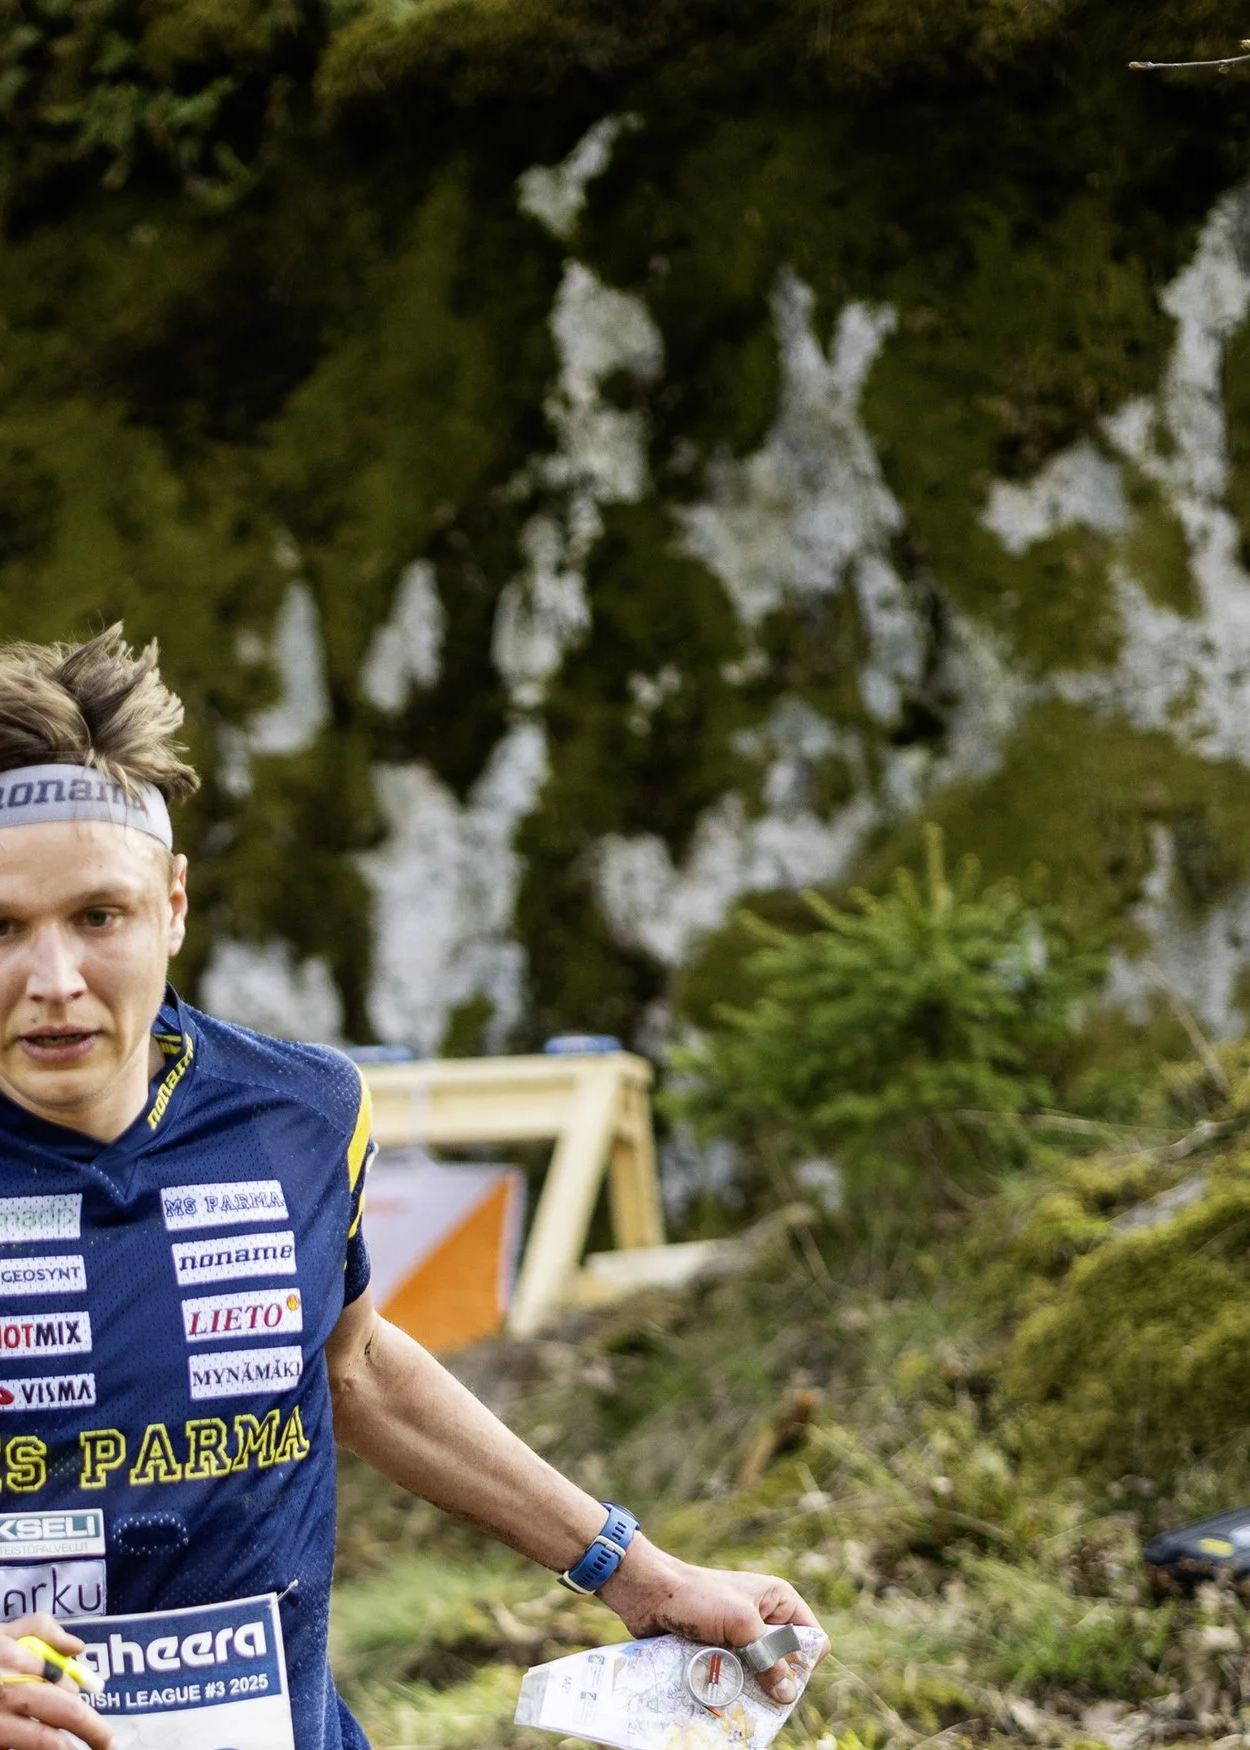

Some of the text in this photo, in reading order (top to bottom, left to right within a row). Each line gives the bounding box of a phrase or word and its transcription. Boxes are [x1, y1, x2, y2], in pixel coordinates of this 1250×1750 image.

[164, 1192, 284, 1217] MS PARMA
[179, 1245, 293, 1271] noname
[1, 1266, 80, 1283] GEOSYNT
[189, 1303, 283, 1335] LIETO
[192, 1360, 302, 1387] MYNÄMÄKI
[21, 1380, 92, 1404] VISMA
[79, 1405, 311, 1490] PARMA
[77, 1621, 267, 1681] gheera
[78, 1674, 269, 1709] DISH LEAGUE #3 2025
